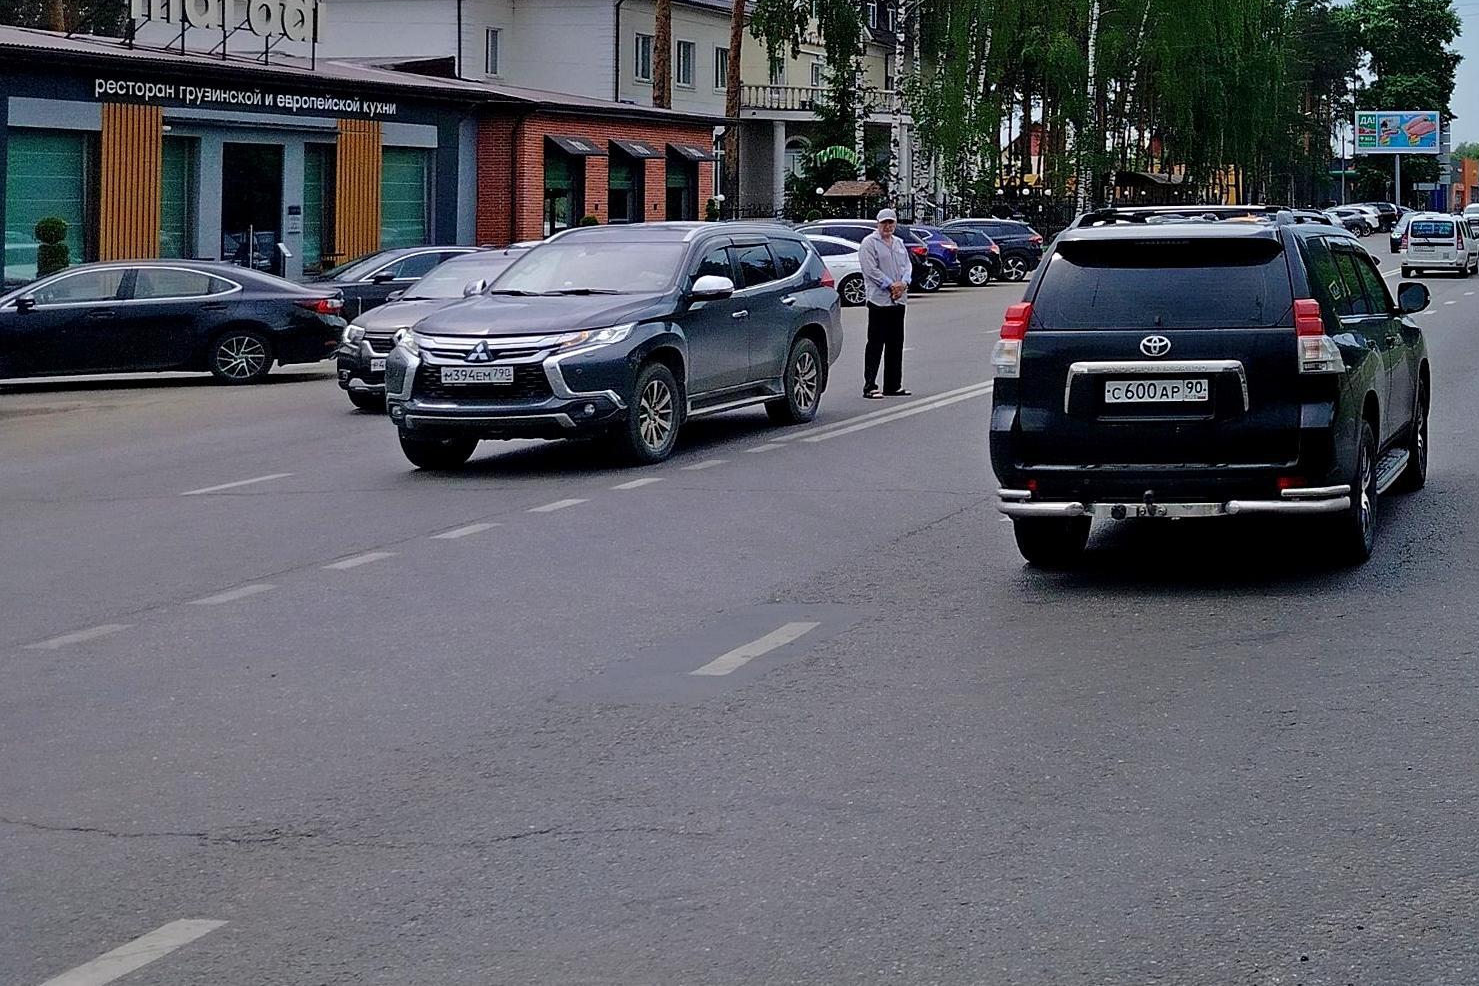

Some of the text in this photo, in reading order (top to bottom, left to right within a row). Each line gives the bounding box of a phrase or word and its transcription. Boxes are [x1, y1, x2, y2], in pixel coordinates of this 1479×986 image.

[95, 78, 397, 117] ресторан грузинской и европейской кухни
[1185, 381, 1203, 394] 90
